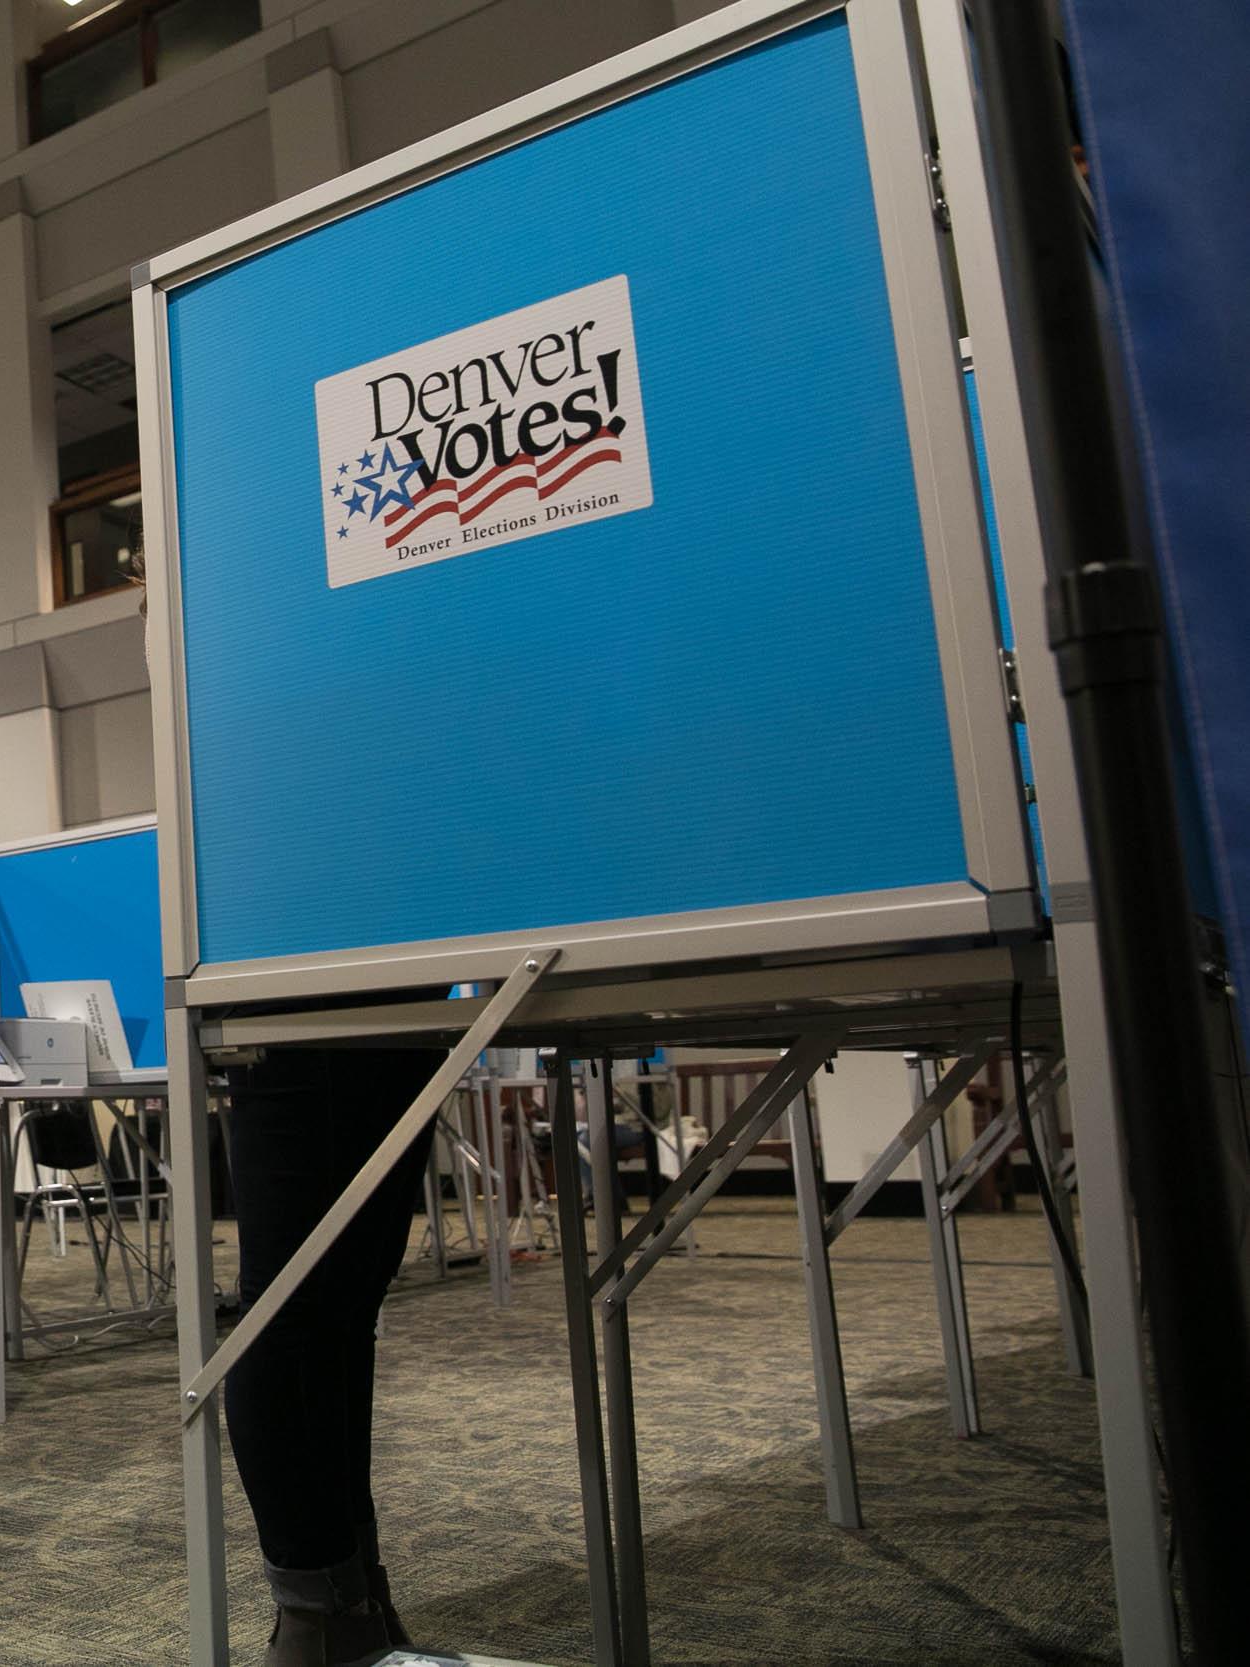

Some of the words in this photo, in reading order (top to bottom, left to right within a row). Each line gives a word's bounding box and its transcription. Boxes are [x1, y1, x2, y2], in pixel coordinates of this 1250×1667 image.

[365, 319, 596, 442] Denver
[396, 348, 627, 491] Votes!
[396, 536, 452, 561] Denver
[461, 514, 538, 544] Elections
[545, 493, 621, 522] Division
